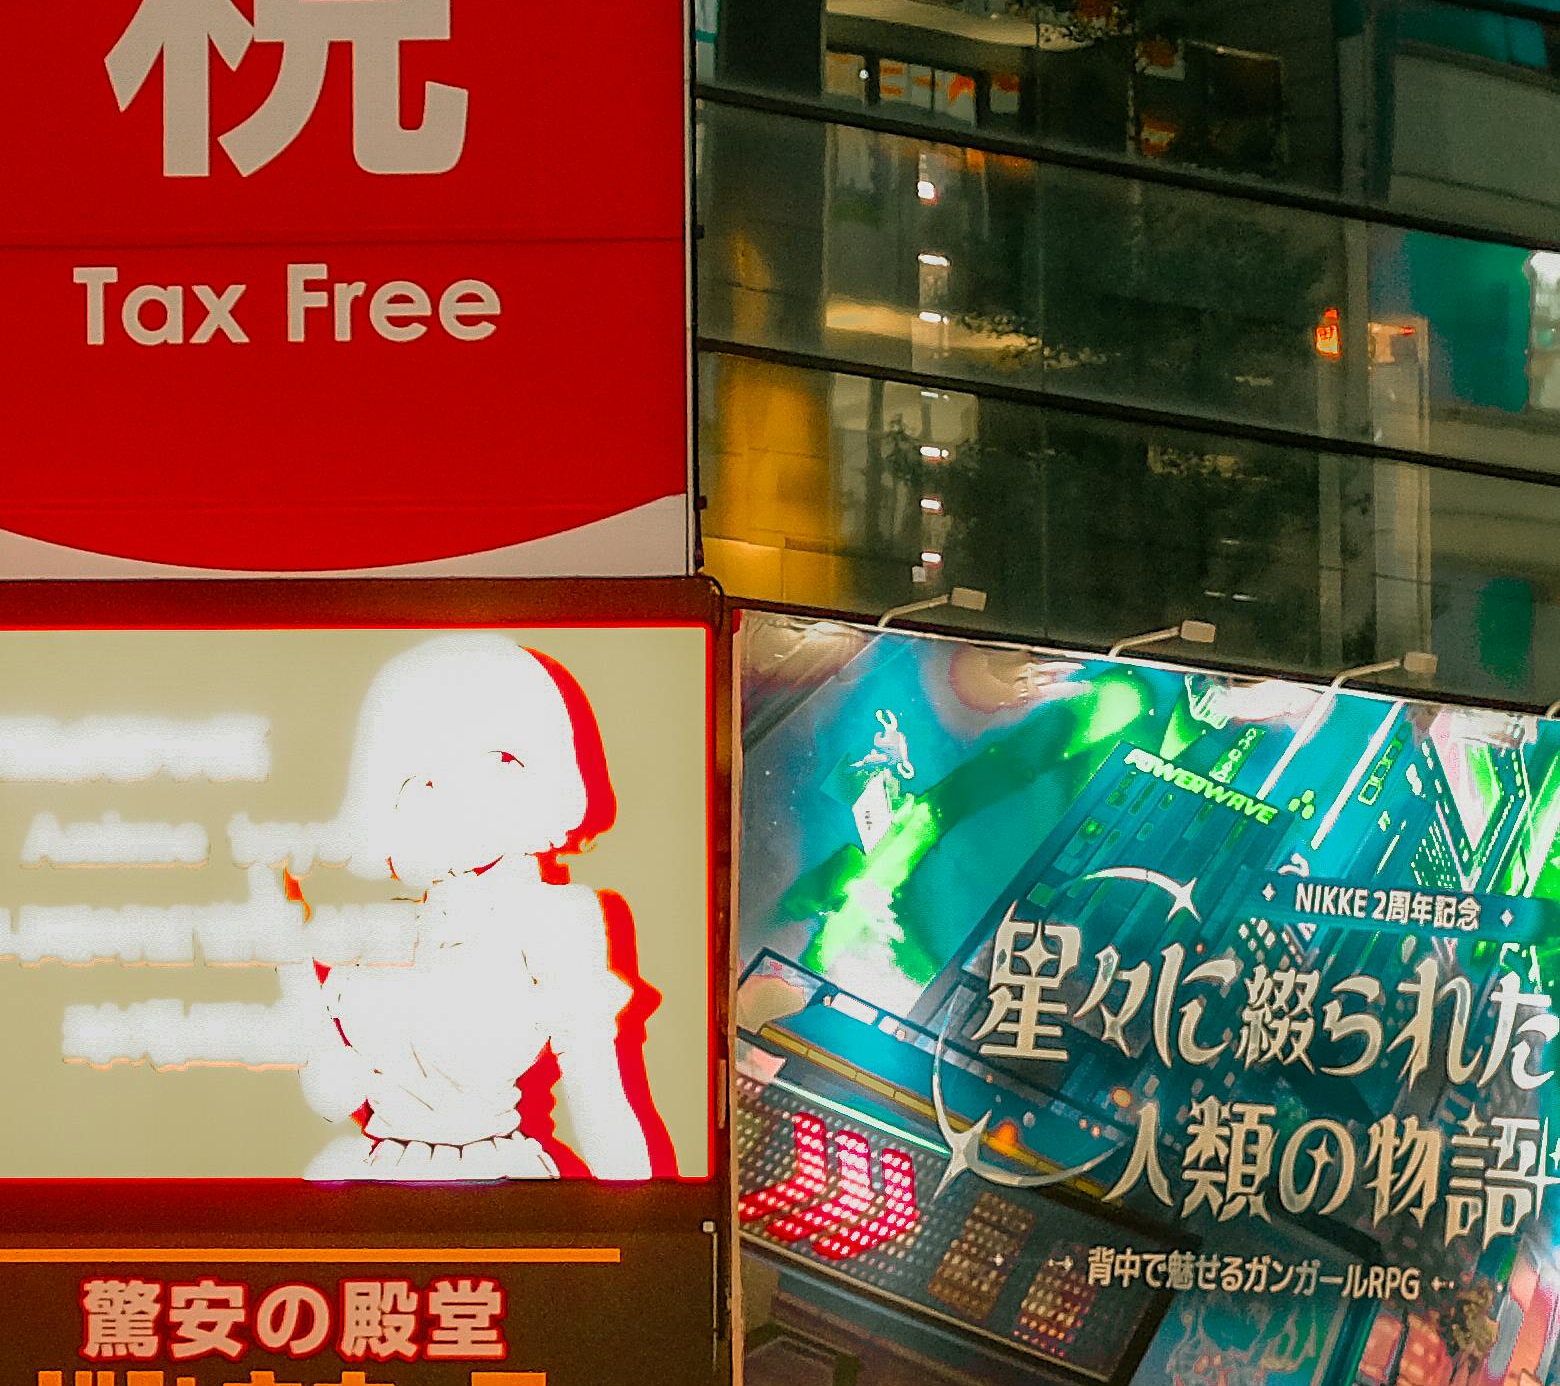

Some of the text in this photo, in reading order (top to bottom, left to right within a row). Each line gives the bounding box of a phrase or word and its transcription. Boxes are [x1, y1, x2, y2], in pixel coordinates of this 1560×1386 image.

[72, 263, 502, 345] Tax Free
[1295, 882, 1481, 931] NIKKE 2周年記念
[973, 900, 1560, 1091] 星々に綴られた
[1087, 1246, 1421, 1301] 背中で魅せるガンガールRPG
[83, 1279, 507, 1360] 驚安の殿堂
